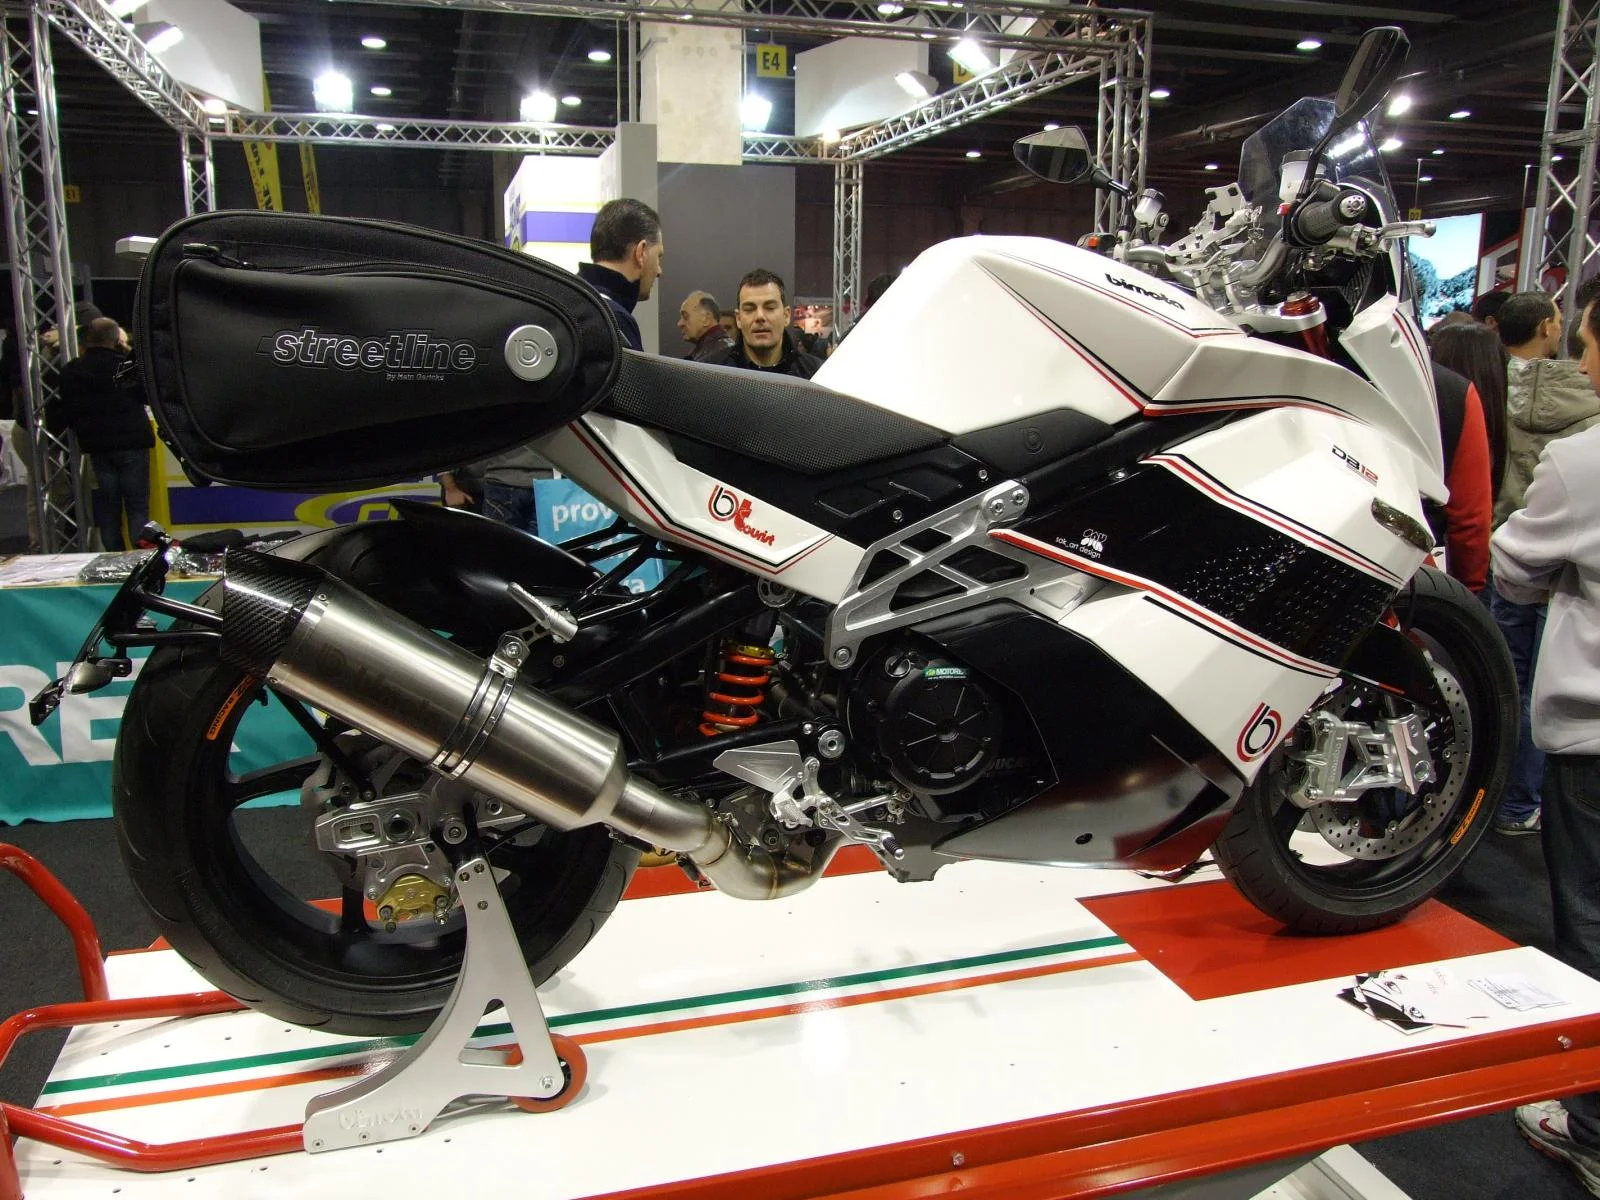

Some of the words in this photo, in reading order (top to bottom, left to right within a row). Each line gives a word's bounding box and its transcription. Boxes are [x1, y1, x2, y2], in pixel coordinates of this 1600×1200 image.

[762, 51, 780, 70] E4
[1104, 272, 1185, 312] bimota
[273, 329, 477, 370] streetline
[1331, 443, 1379, 484] DB12
[1079, 545, 1102, 559] design
